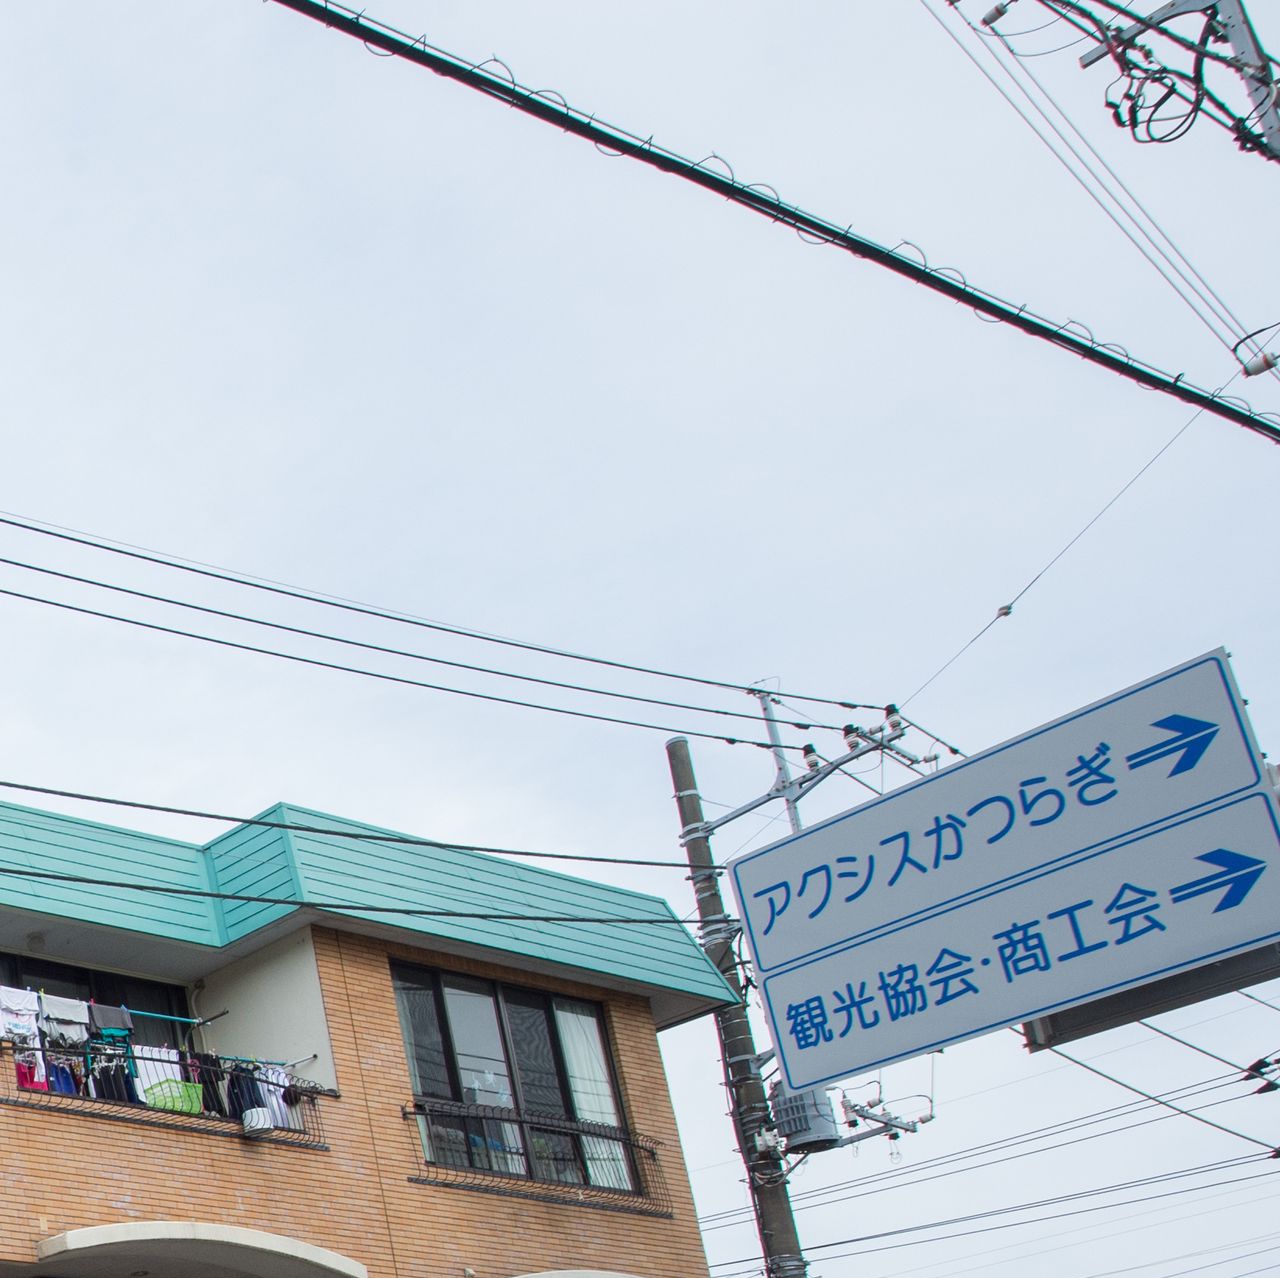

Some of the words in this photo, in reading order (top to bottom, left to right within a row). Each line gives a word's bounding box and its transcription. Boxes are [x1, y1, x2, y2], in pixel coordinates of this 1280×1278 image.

[754, 742, 1118, 936] アクシスかつらぎ
[786, 882, 1167, 1051] 観光協会・商工会
